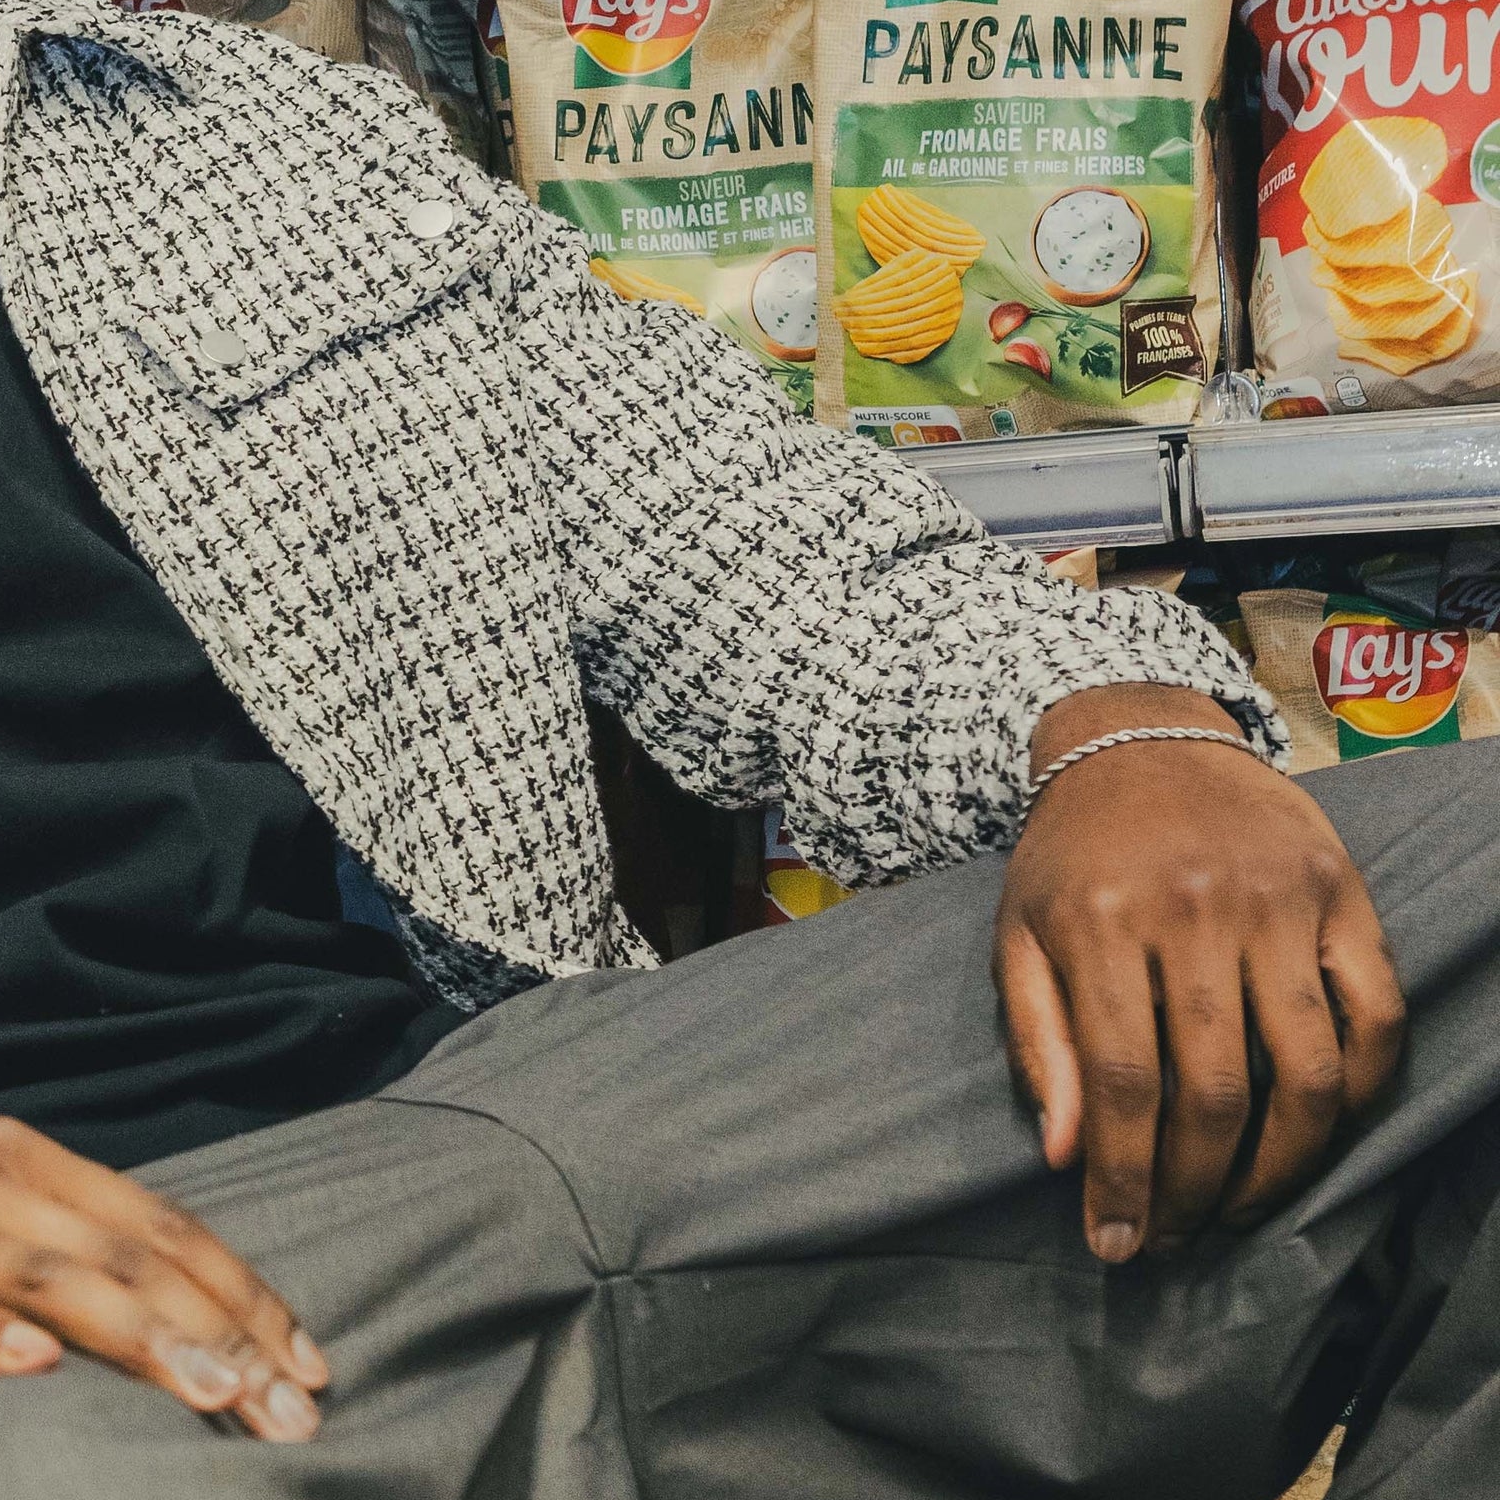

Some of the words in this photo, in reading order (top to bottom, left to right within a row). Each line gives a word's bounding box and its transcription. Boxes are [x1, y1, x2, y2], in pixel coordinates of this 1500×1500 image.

[861, 13, 1188, 86] PAYSANNE
[554, 81, 814, 166] PAYSANN
[972, 102, 1046, 126] SAVEUR
[918, 127, 1023, 155] FROMAGE
[1035, 126, 1109, 152] FRAIS
[881, 158, 908, 179] AIL
[911, 162, 927, 176] DE
[928, 157, 1009, 178] GARONNE
[1013, 160, 1029, 174] ET
[1033, 159, 1069, 175] FINES
[1073, 155, 1146, 177] HERBES
[679, 174, 746, 203] SAVEUR
[1257, 162, 1297, 207] NATURE
[621, 199, 729, 231] FROMAGE
[740, 190, 808, 222] FRAIS
[590, 231, 618, 252] AIL
[621, 237, 634, 251] DE
[636, 230, 719, 252] GARONNE
[723, 232, 738, 246] ET
[742, 226, 775, 243] FINES
[779, 216, 815, 241] HER
[1128, 312, 1157, 333] POMMES
[1156, 311, 1166, 324] DE
[1165, 311, 1188, 324] TERRE
[1141, 325, 1184, 350] 100%
[1136, 343, 1195, 366] FRANÇAISES
[854, 410, 932, 423] NUTRI-SCORE
